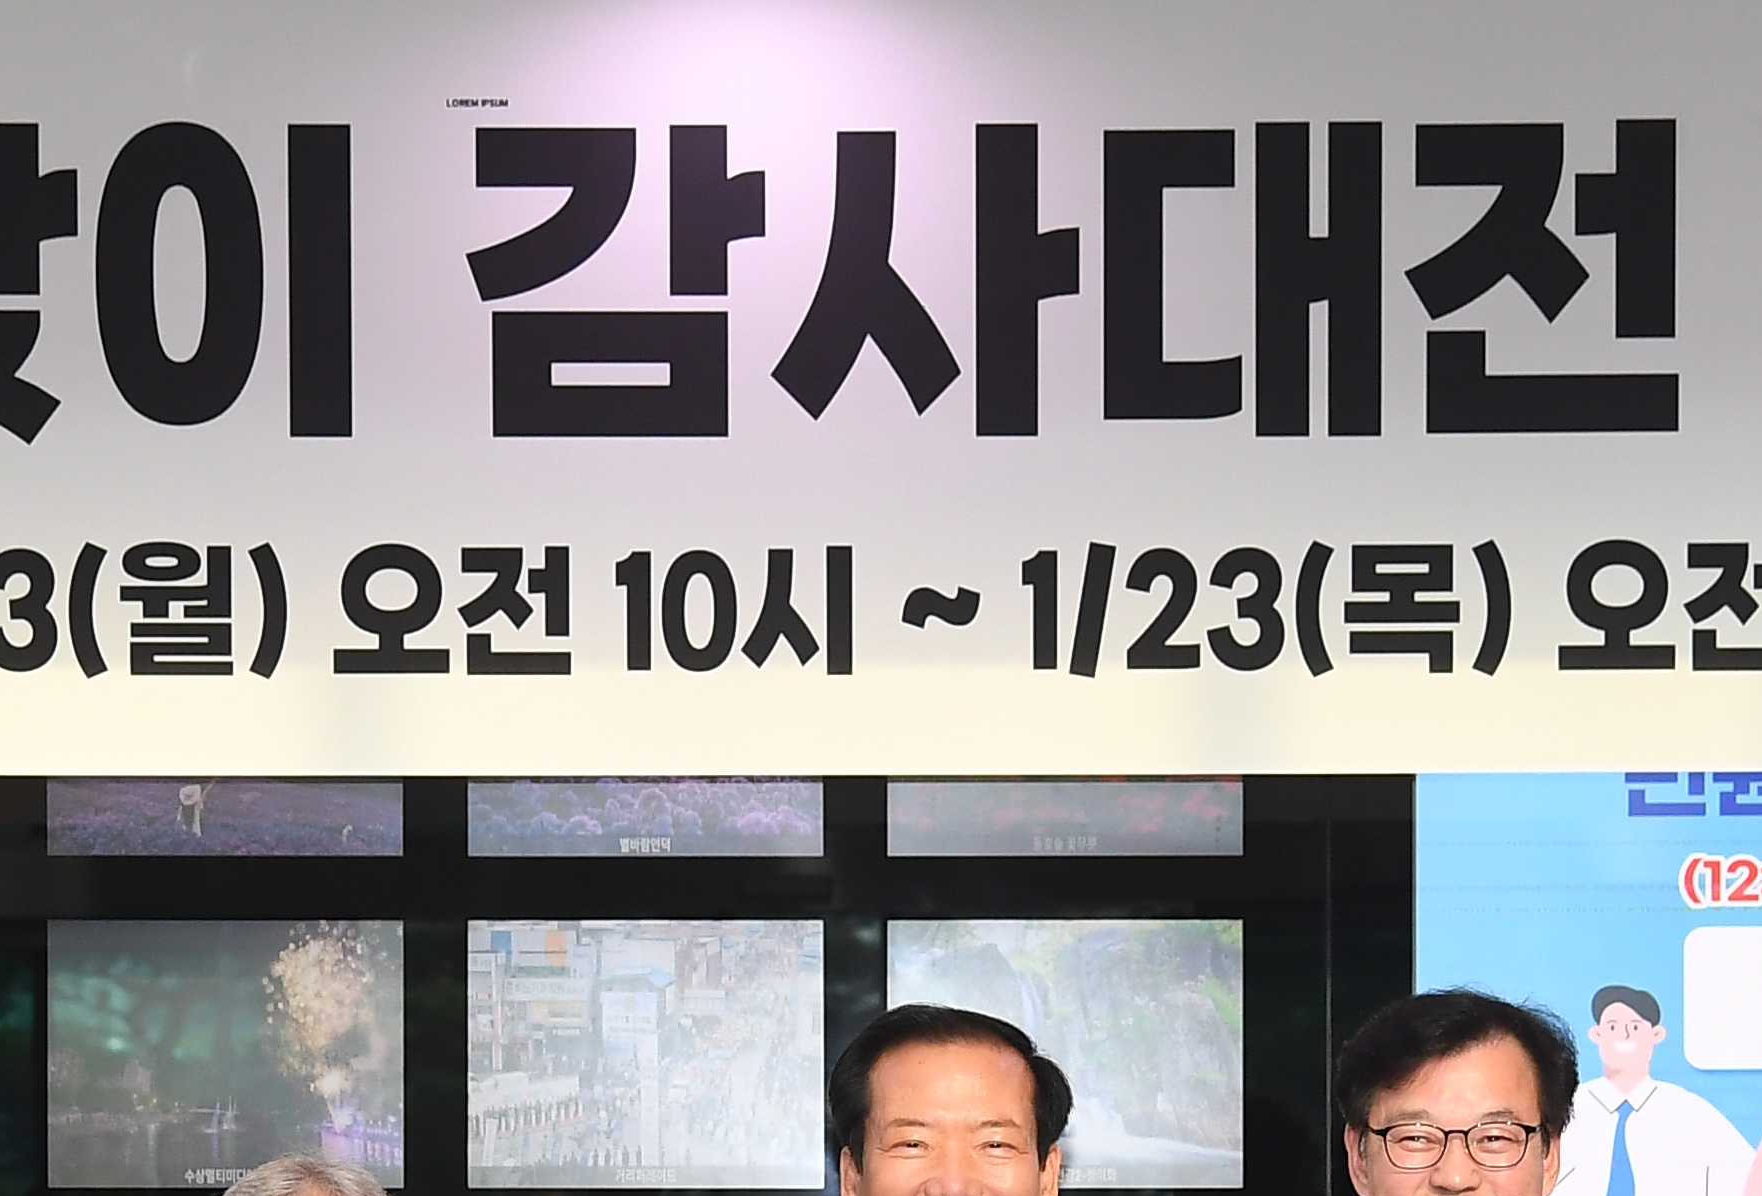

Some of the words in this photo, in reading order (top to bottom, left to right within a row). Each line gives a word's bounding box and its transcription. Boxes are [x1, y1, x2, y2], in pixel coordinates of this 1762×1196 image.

[445, 99, 479, 108] LOREM
[481, 99, 509, 108] IPSUM
[468, 119, 1679, 437] 감사대전
[334, 544, 571, 674] 오전
[616, 546, 852, 674] 10시
[902, 588, 980, 627] ~
[1022, 541, 1511, 677] 1/23(목)
